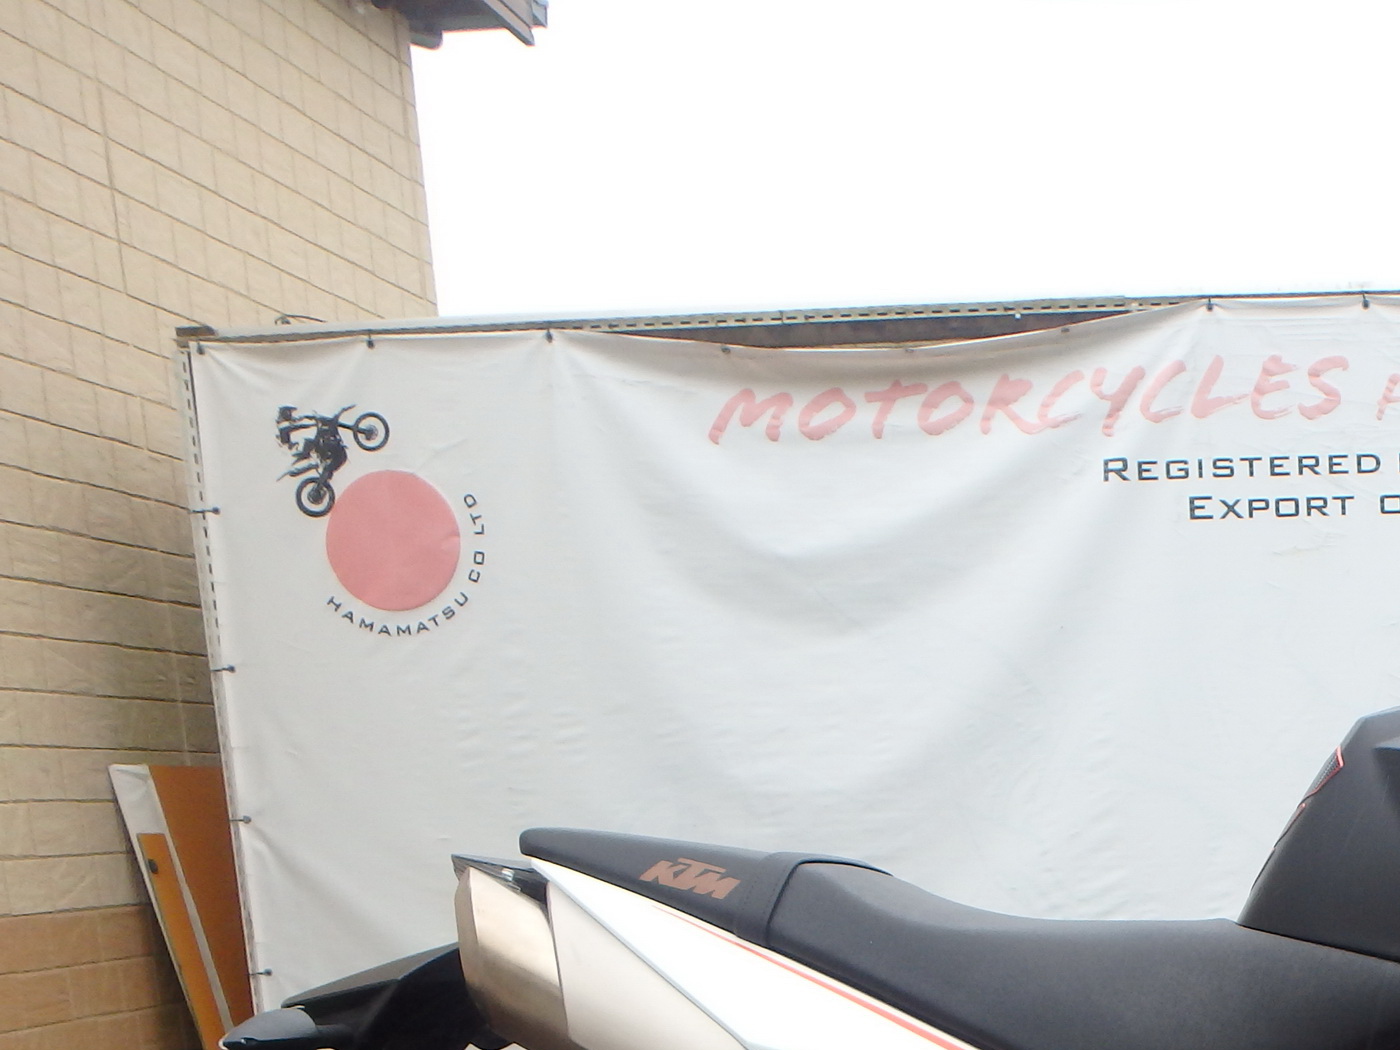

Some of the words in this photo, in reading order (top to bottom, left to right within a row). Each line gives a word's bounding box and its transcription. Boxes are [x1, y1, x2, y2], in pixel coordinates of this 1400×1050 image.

[708, 354, 1350, 445] MOTORCYCLES
[463, 493, 485, 536] LTD
[467, 550, 485, 583] CO
[326, 591, 470, 637] HAMAMATSU
[638, 857, 742, 900] KTM
